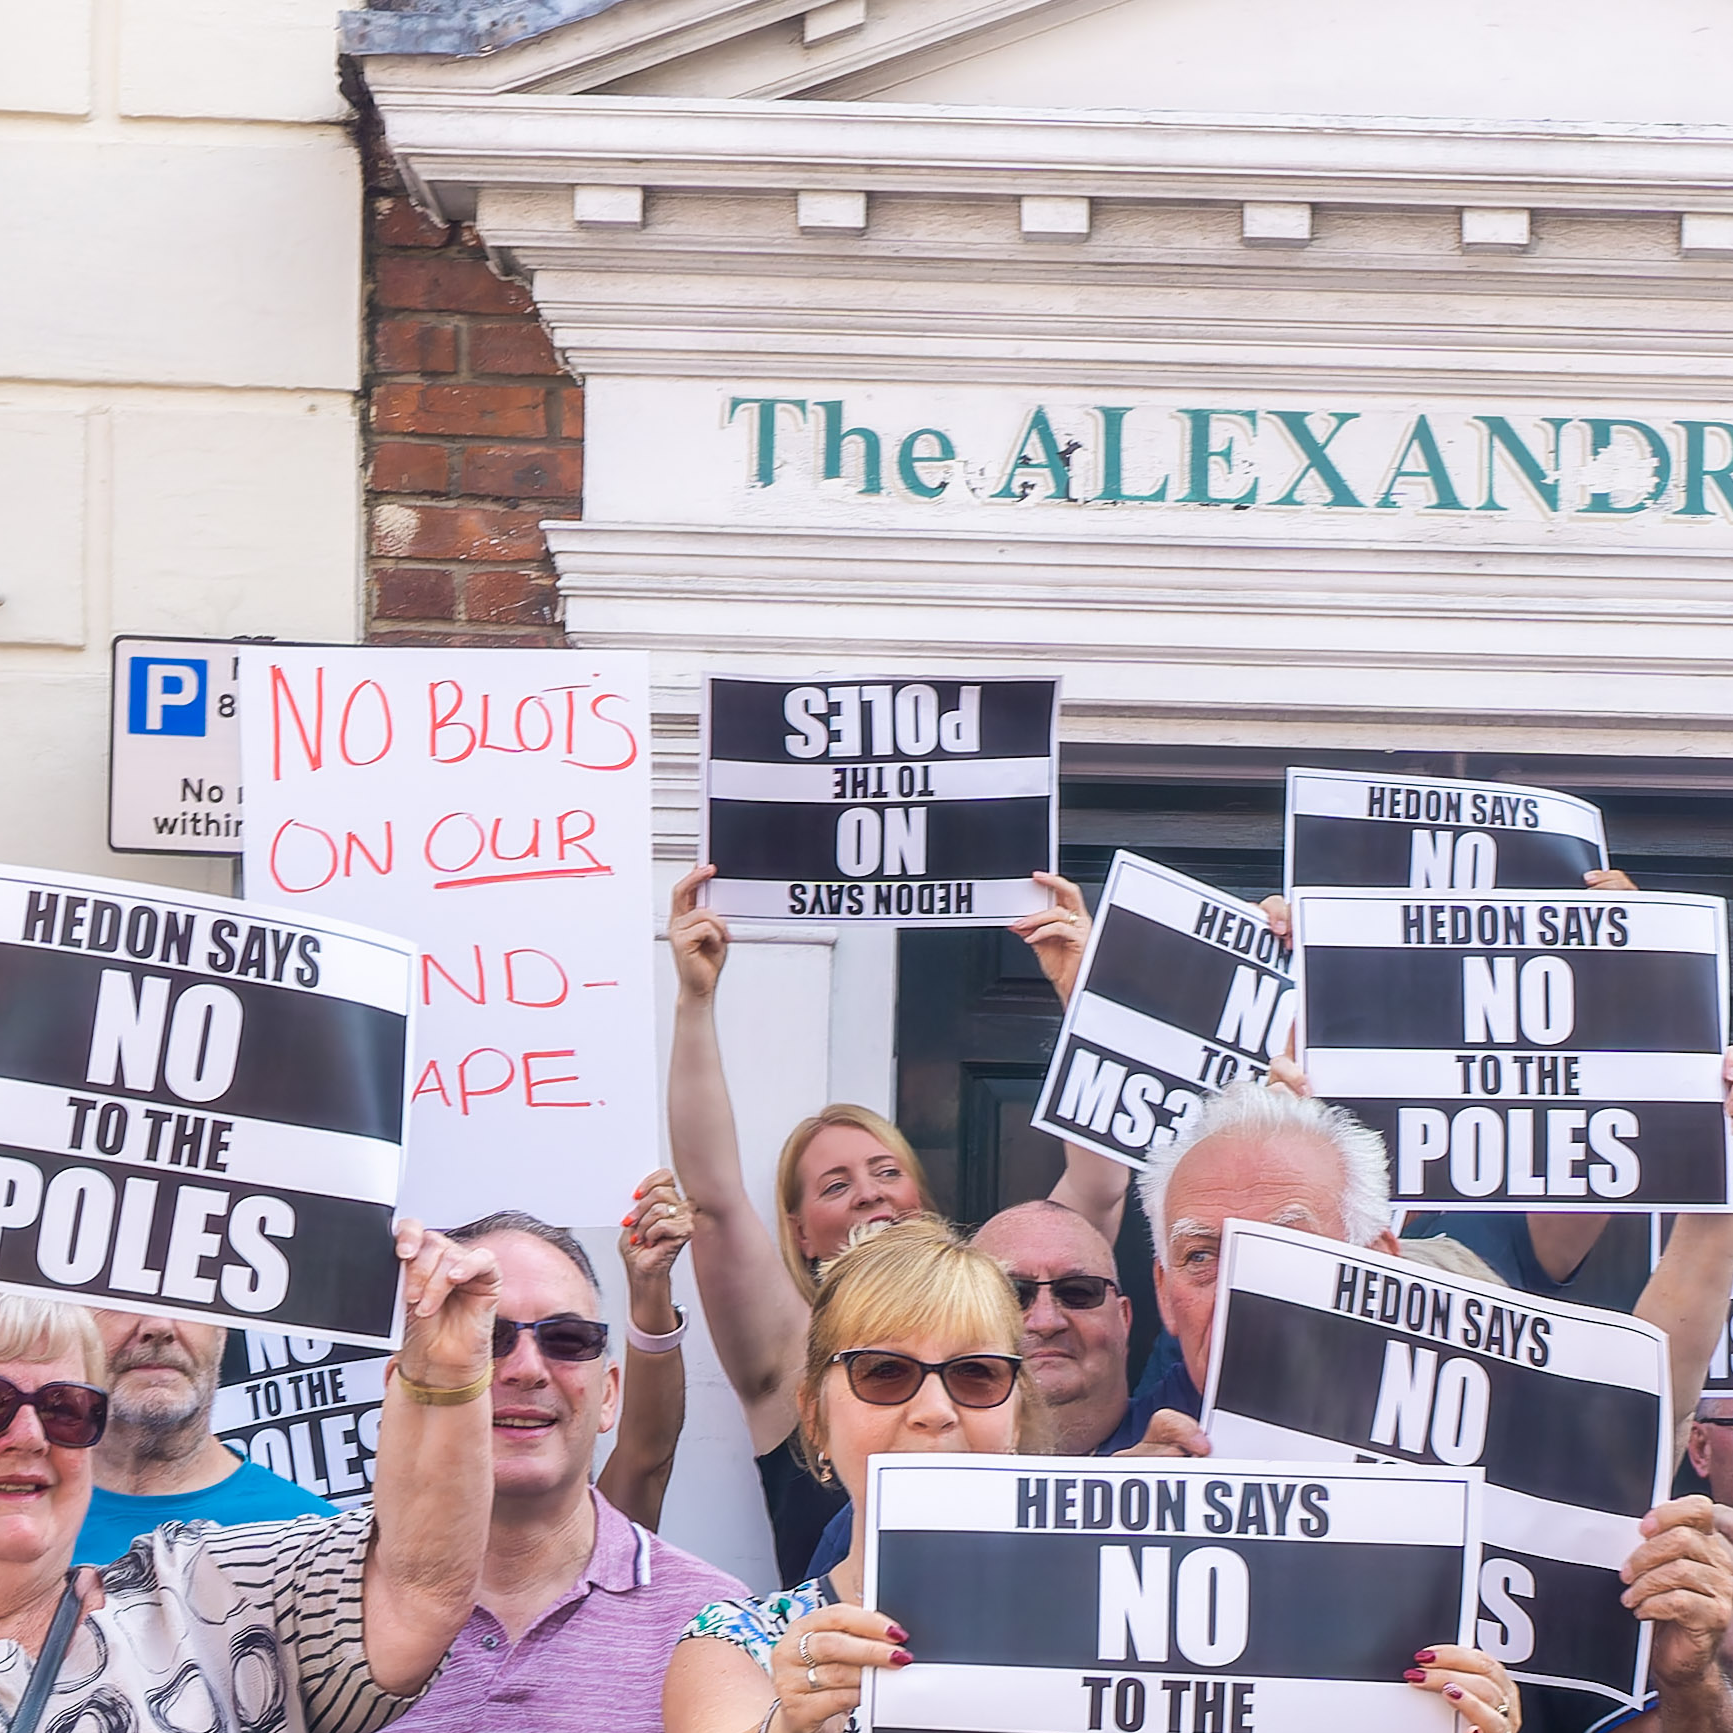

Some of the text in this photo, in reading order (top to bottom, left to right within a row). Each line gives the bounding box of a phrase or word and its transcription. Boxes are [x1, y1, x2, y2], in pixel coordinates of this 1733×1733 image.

[727, 396, 956, 500] The
[269, 664, 394, 781] NO
[784, 683, 982, 759] POLES
[180, 778, 223, 803] No
[833, 765, 935, 800] TO THE
[1367, 787, 1539, 829] HEDON SAYS
[269, 819, 394, 894] ON
[424, 809, 601, 872] OUR
[835, 806, 928, 877] NO
[1410, 829, 1498, 889] NO
[789, 882, 974, 916] HEDON SAYS
[1401, 905, 1628, 948] HEDON SAYS
[23, 890, 321, 989] HEDON SAYS
[420, 945, 619, 1008] ND-
[1462, 955, 1575, 1046] NO
[86, 968, 243, 1104] NO
[412, 1048, 605, 1116] APE.
[1056, 1048, 1203, 1147] MS3
[1454, 1055, 1582, 1097] TO THE
[68, 1097, 233, 1174] TO THE
[1397, 1106, 1641, 1199] POLES
[1332, 1262, 1552, 1368] HEDON SAYS
[245, 1368, 346, 1420] TO THE
[1370, 1339, 1491, 1466] NO
[220, 1407, 382, 1495] OLES
[1016, 1477, 1330, 1539] HEDON SAYS
[1096, 1543, 1250, 1668] NO
[1081, 1675, 1145, 1733] TO
